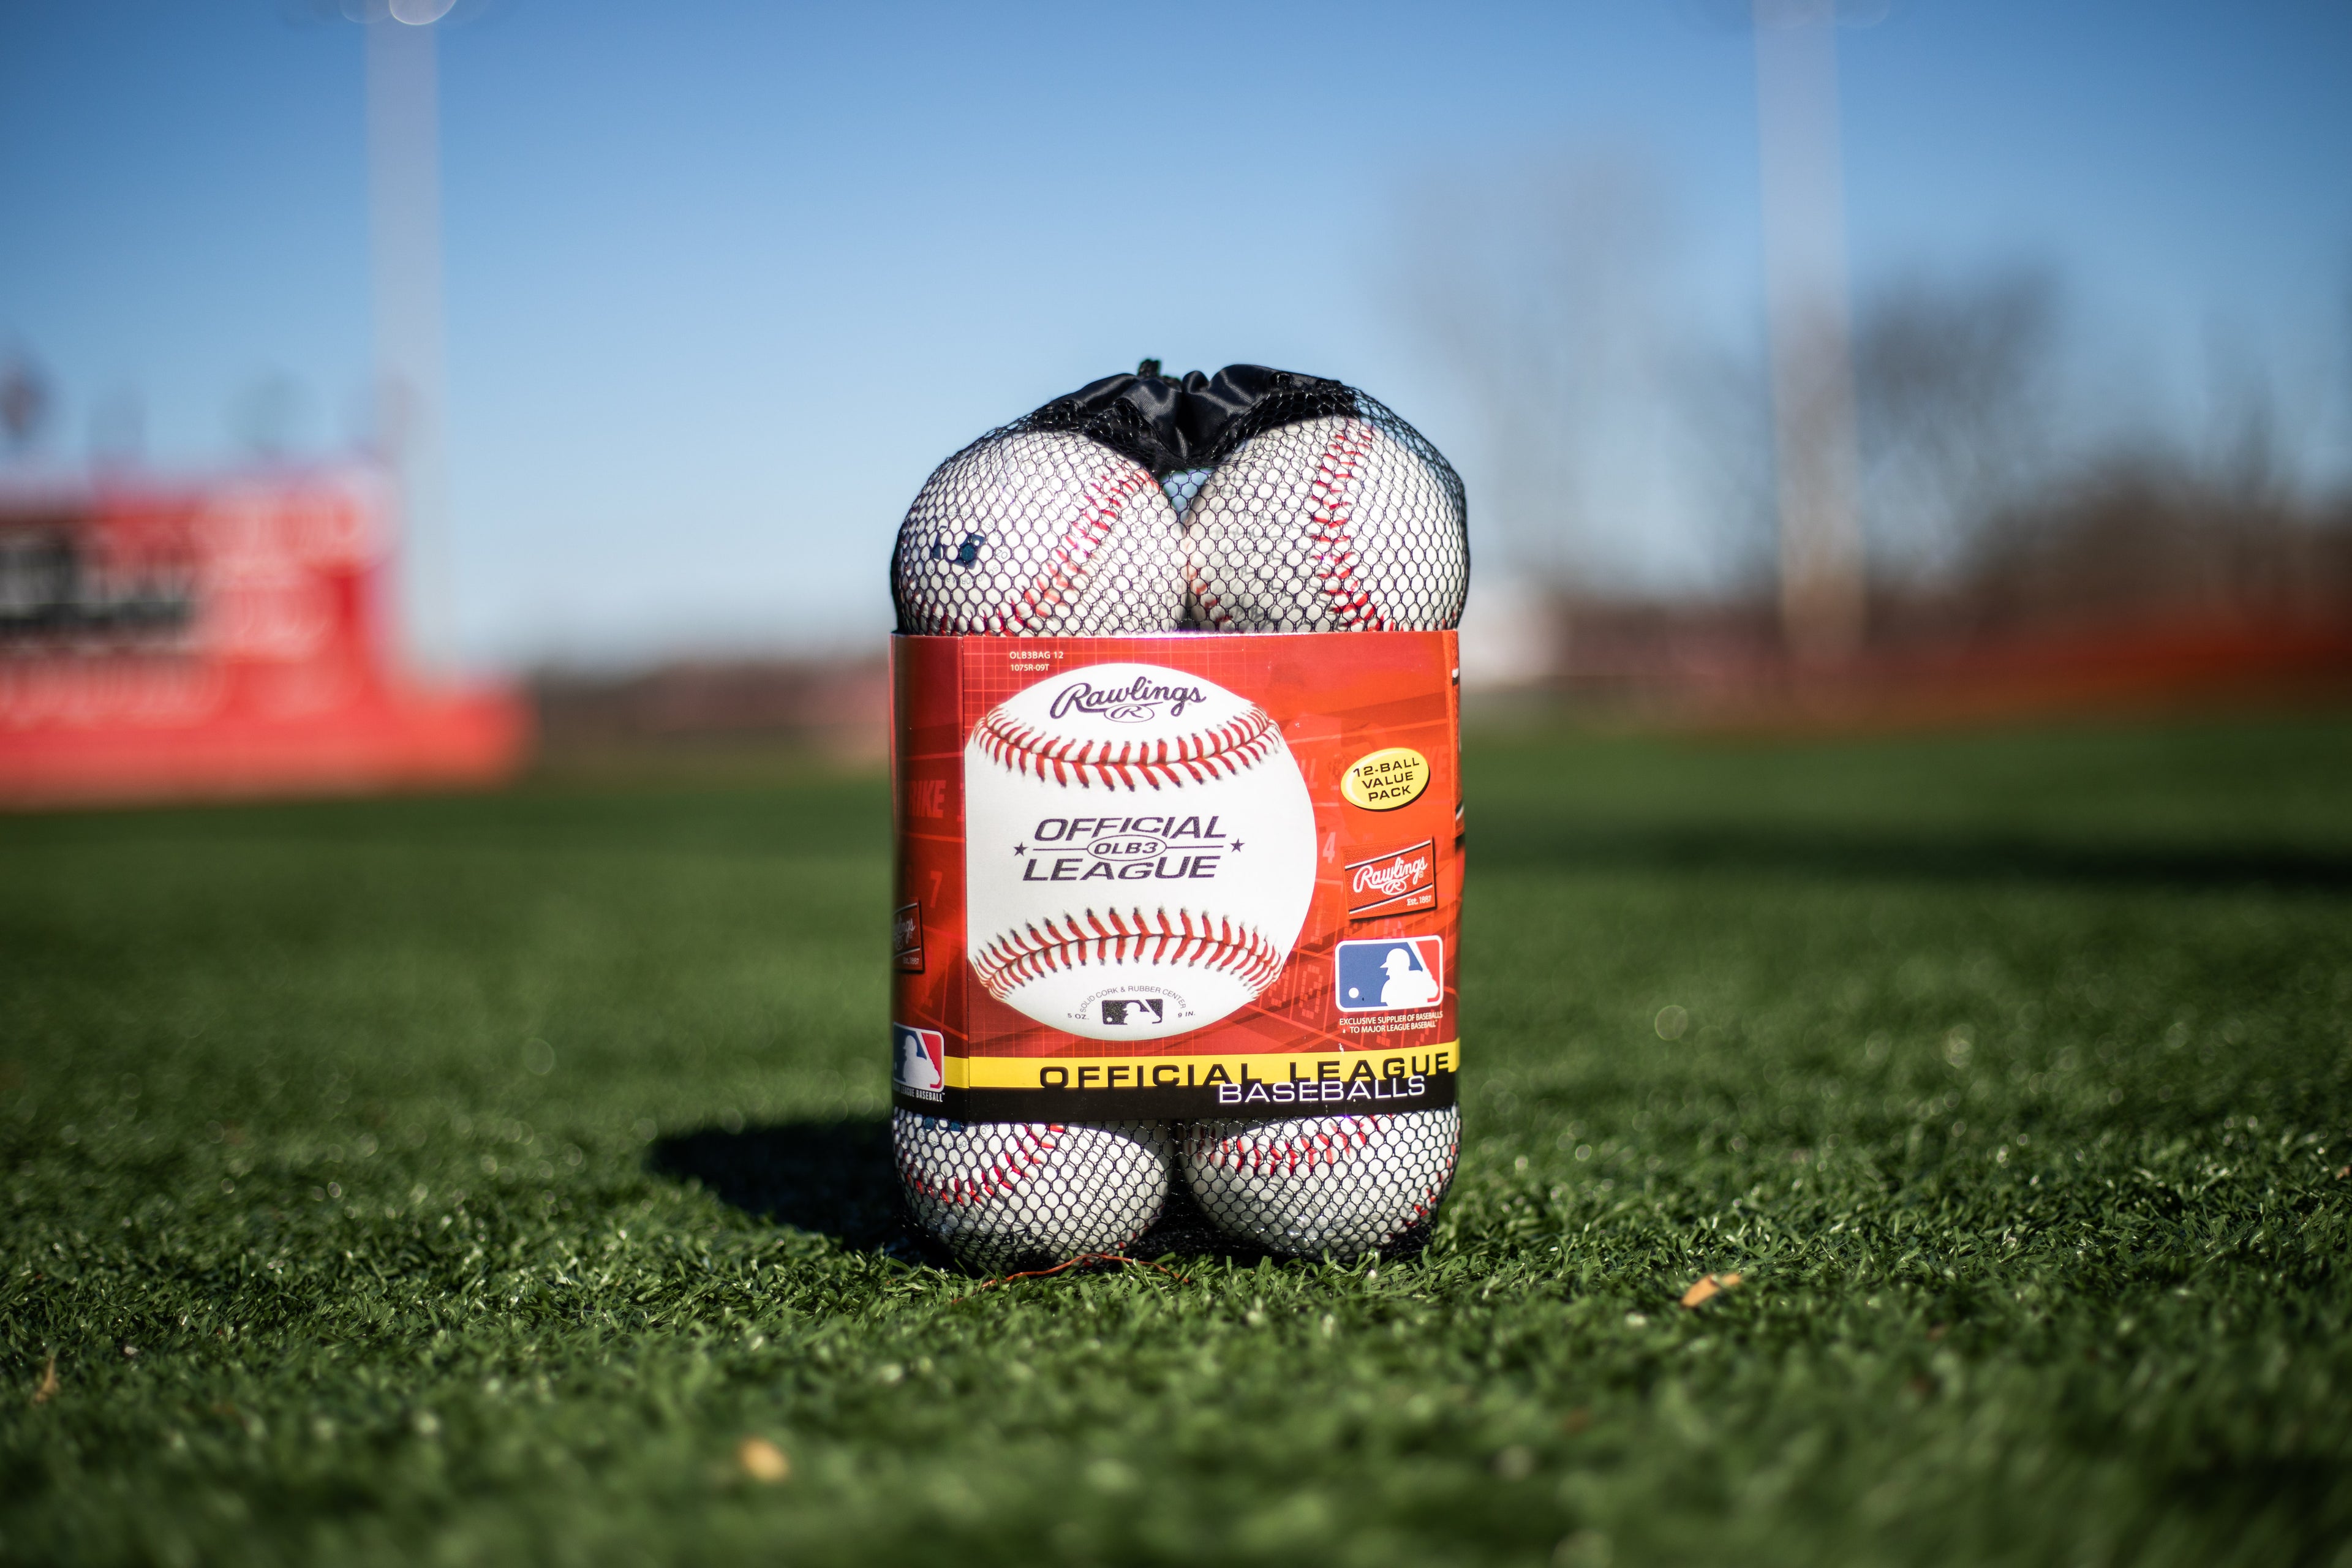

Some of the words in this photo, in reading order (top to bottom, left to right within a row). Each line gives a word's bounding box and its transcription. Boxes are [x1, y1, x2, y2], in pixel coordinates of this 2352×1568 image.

[1050, 676, 1207, 719] Rawlings
[1353, 757, 1420, 777] 12-BALL
[1362, 771, 1414, 789] VALUE
[1368, 785, 1411, 802] PACK
[1034, 816, 1227, 842] OFFICIAL
[1094, 842, 1159, 854] OLB3
[1022, 856, 1221, 881] LEAGUE
[930, 870, 943, 909] 7
[1419, 895, 1431, 904] 1887
[1080, 995, 1095, 1012] SOLID
[1096, 987, 1119, 998] CORK
[1162, 989, 1186, 1009] CENTER
[1339, 1017, 1376, 1026] EXCLUSIVE
[1378, 1015, 1406, 1024] SUPPLIER
[1415, 1011, 1443, 1021] BASEBALLS
[1361, 1024, 1385, 1033] MAJOR
[1387, 1022, 1410, 1031] LEAGUE
[1039, 1062, 1262, 1088] OFFICIAL
[1290, 1051, 1450, 1082] LEAGUE
[1218, 1074, 1426, 1103] BASEBALLS
